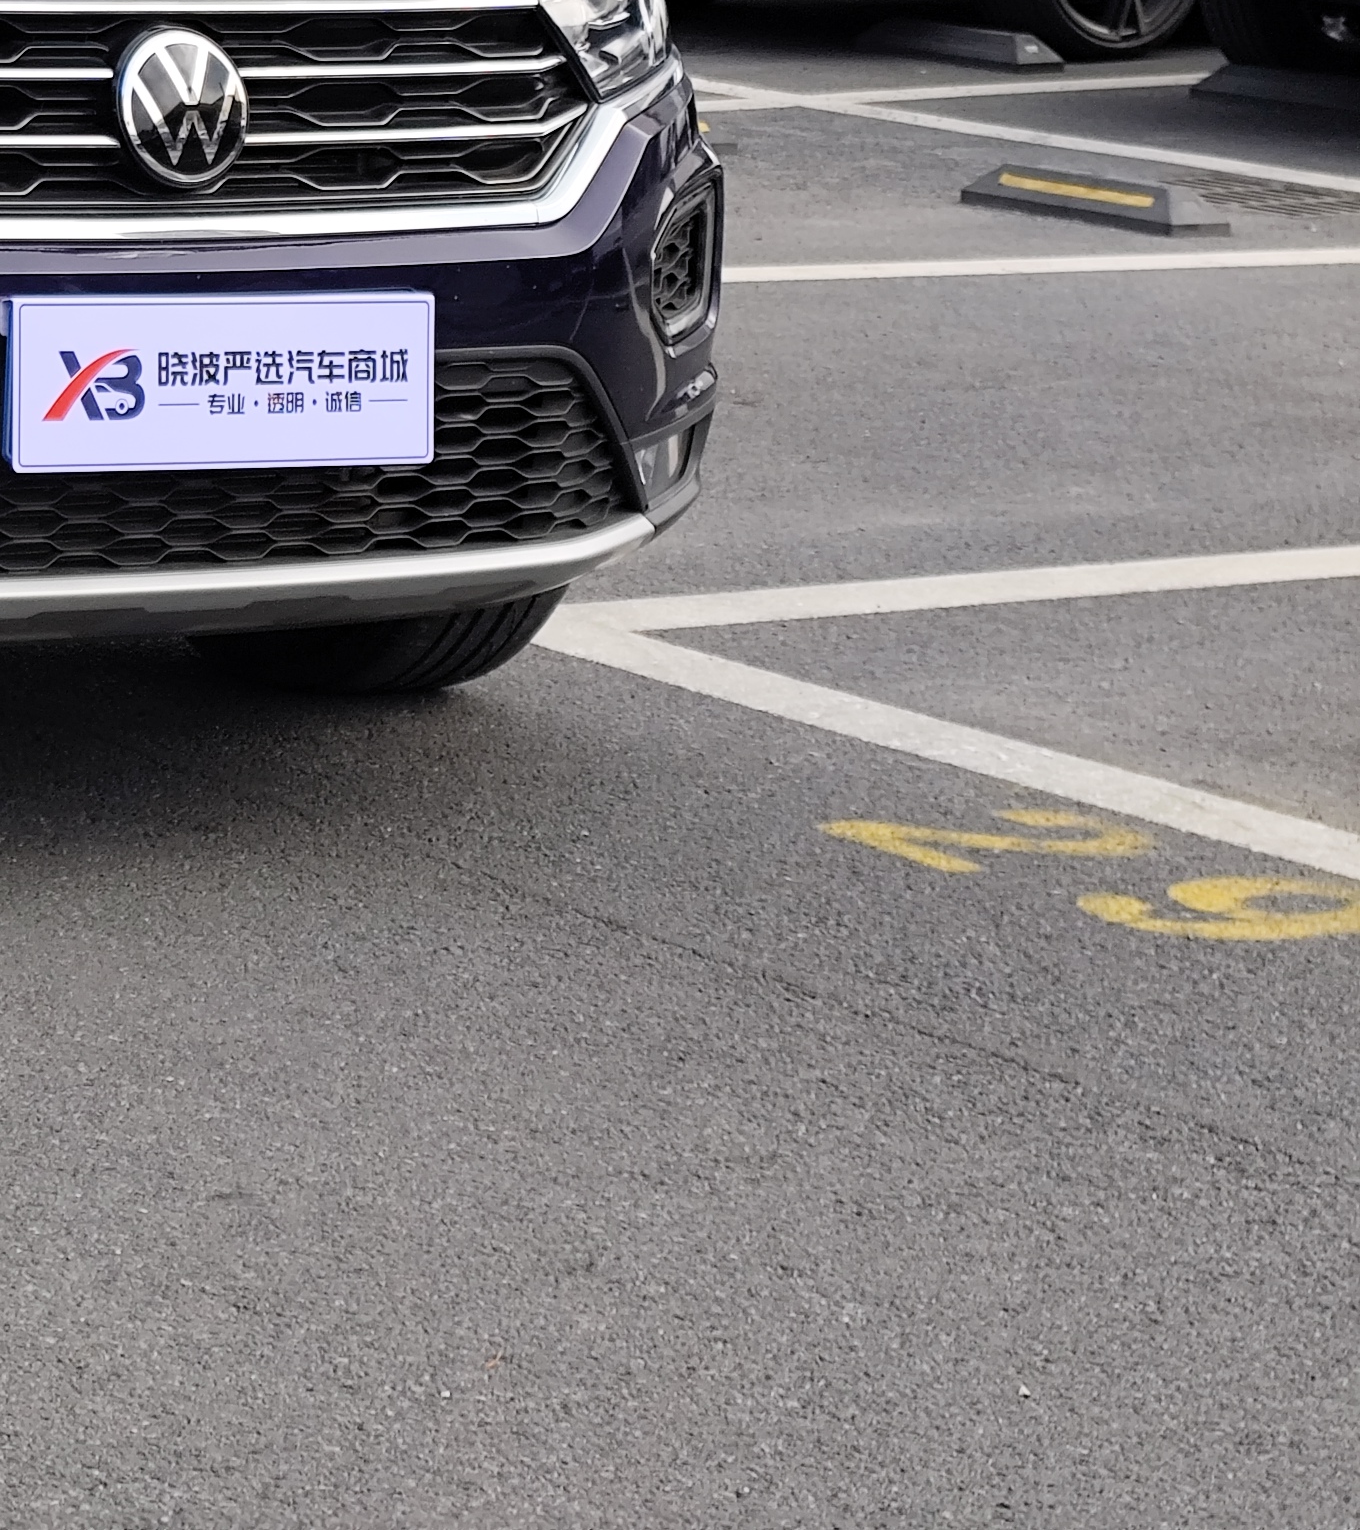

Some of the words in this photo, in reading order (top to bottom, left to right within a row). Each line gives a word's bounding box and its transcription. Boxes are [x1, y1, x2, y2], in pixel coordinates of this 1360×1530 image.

[157, 348, 409, 387] 晓波严选汽车商城
